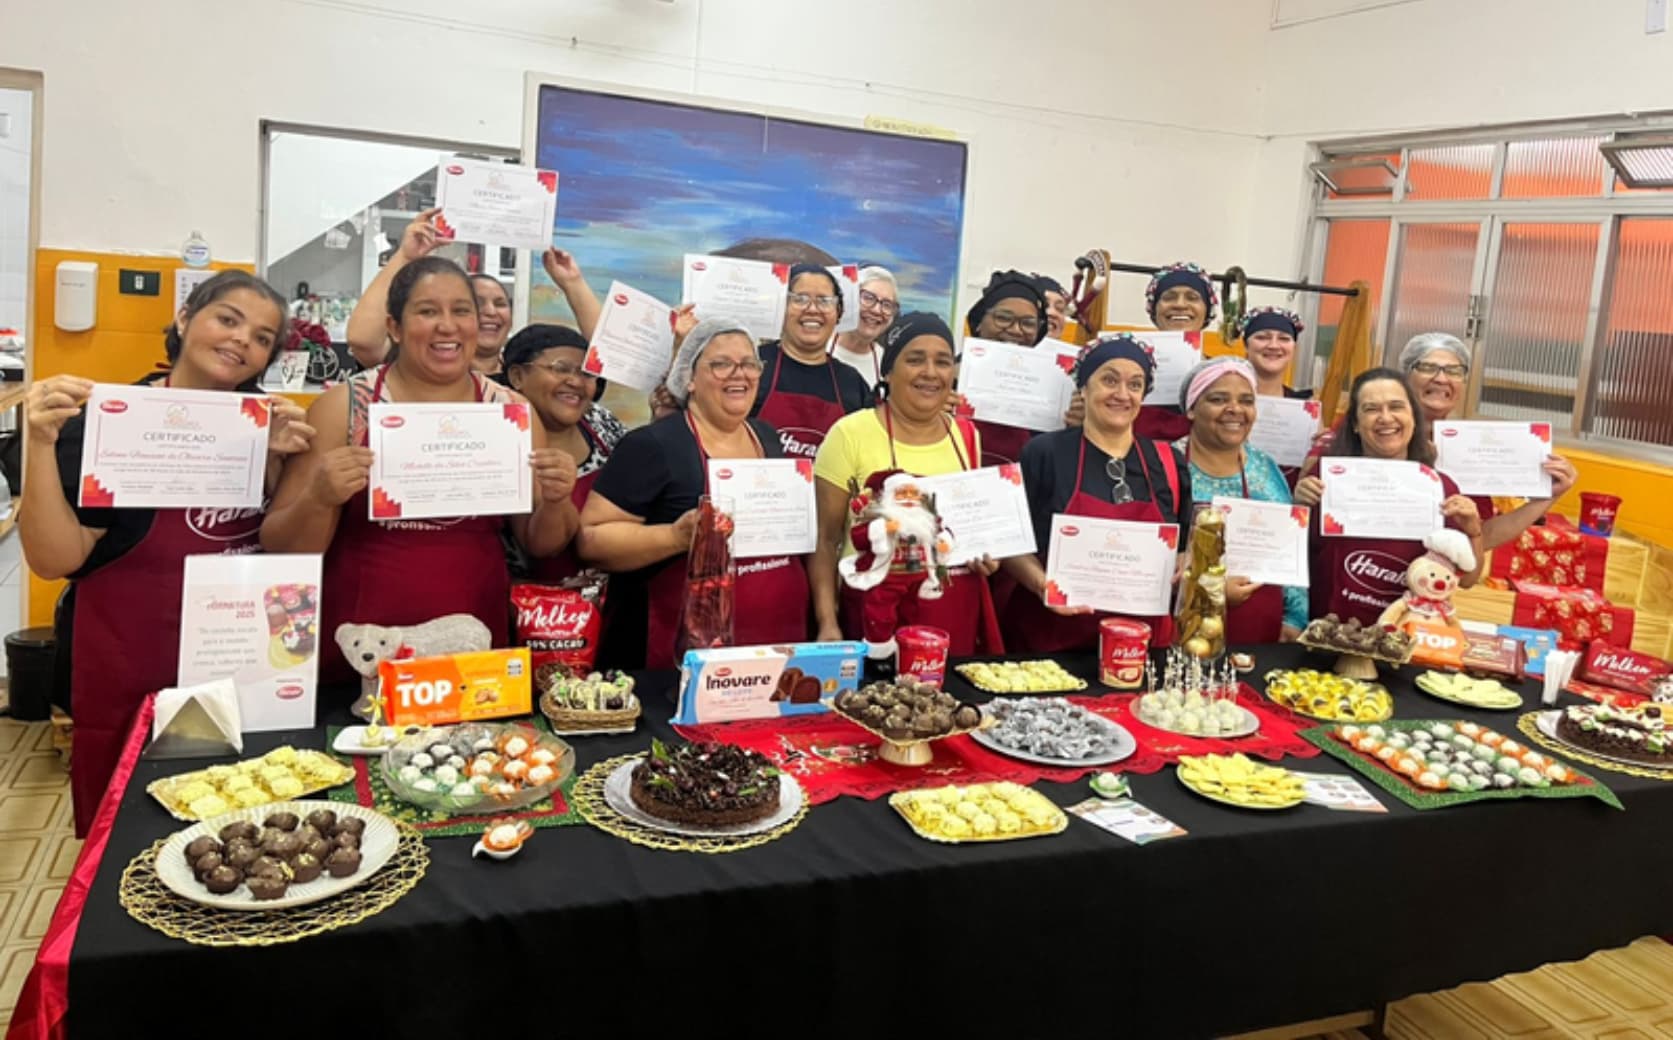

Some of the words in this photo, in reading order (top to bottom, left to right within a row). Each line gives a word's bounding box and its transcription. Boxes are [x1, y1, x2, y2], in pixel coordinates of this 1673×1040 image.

[142, 431, 217, 444] CERTIFICADO
[421, 441, 487, 453] CERTIFICADO
[1088, 549, 1142, 563] CERTIFICADO
[1350, 553, 1408, 584] Haral
[549, 639, 585, 649] CACAU
[1415, 630, 1458, 649] TOP
[705, 674, 771, 692] Inovare
[395, 679, 452, 708] TOP
